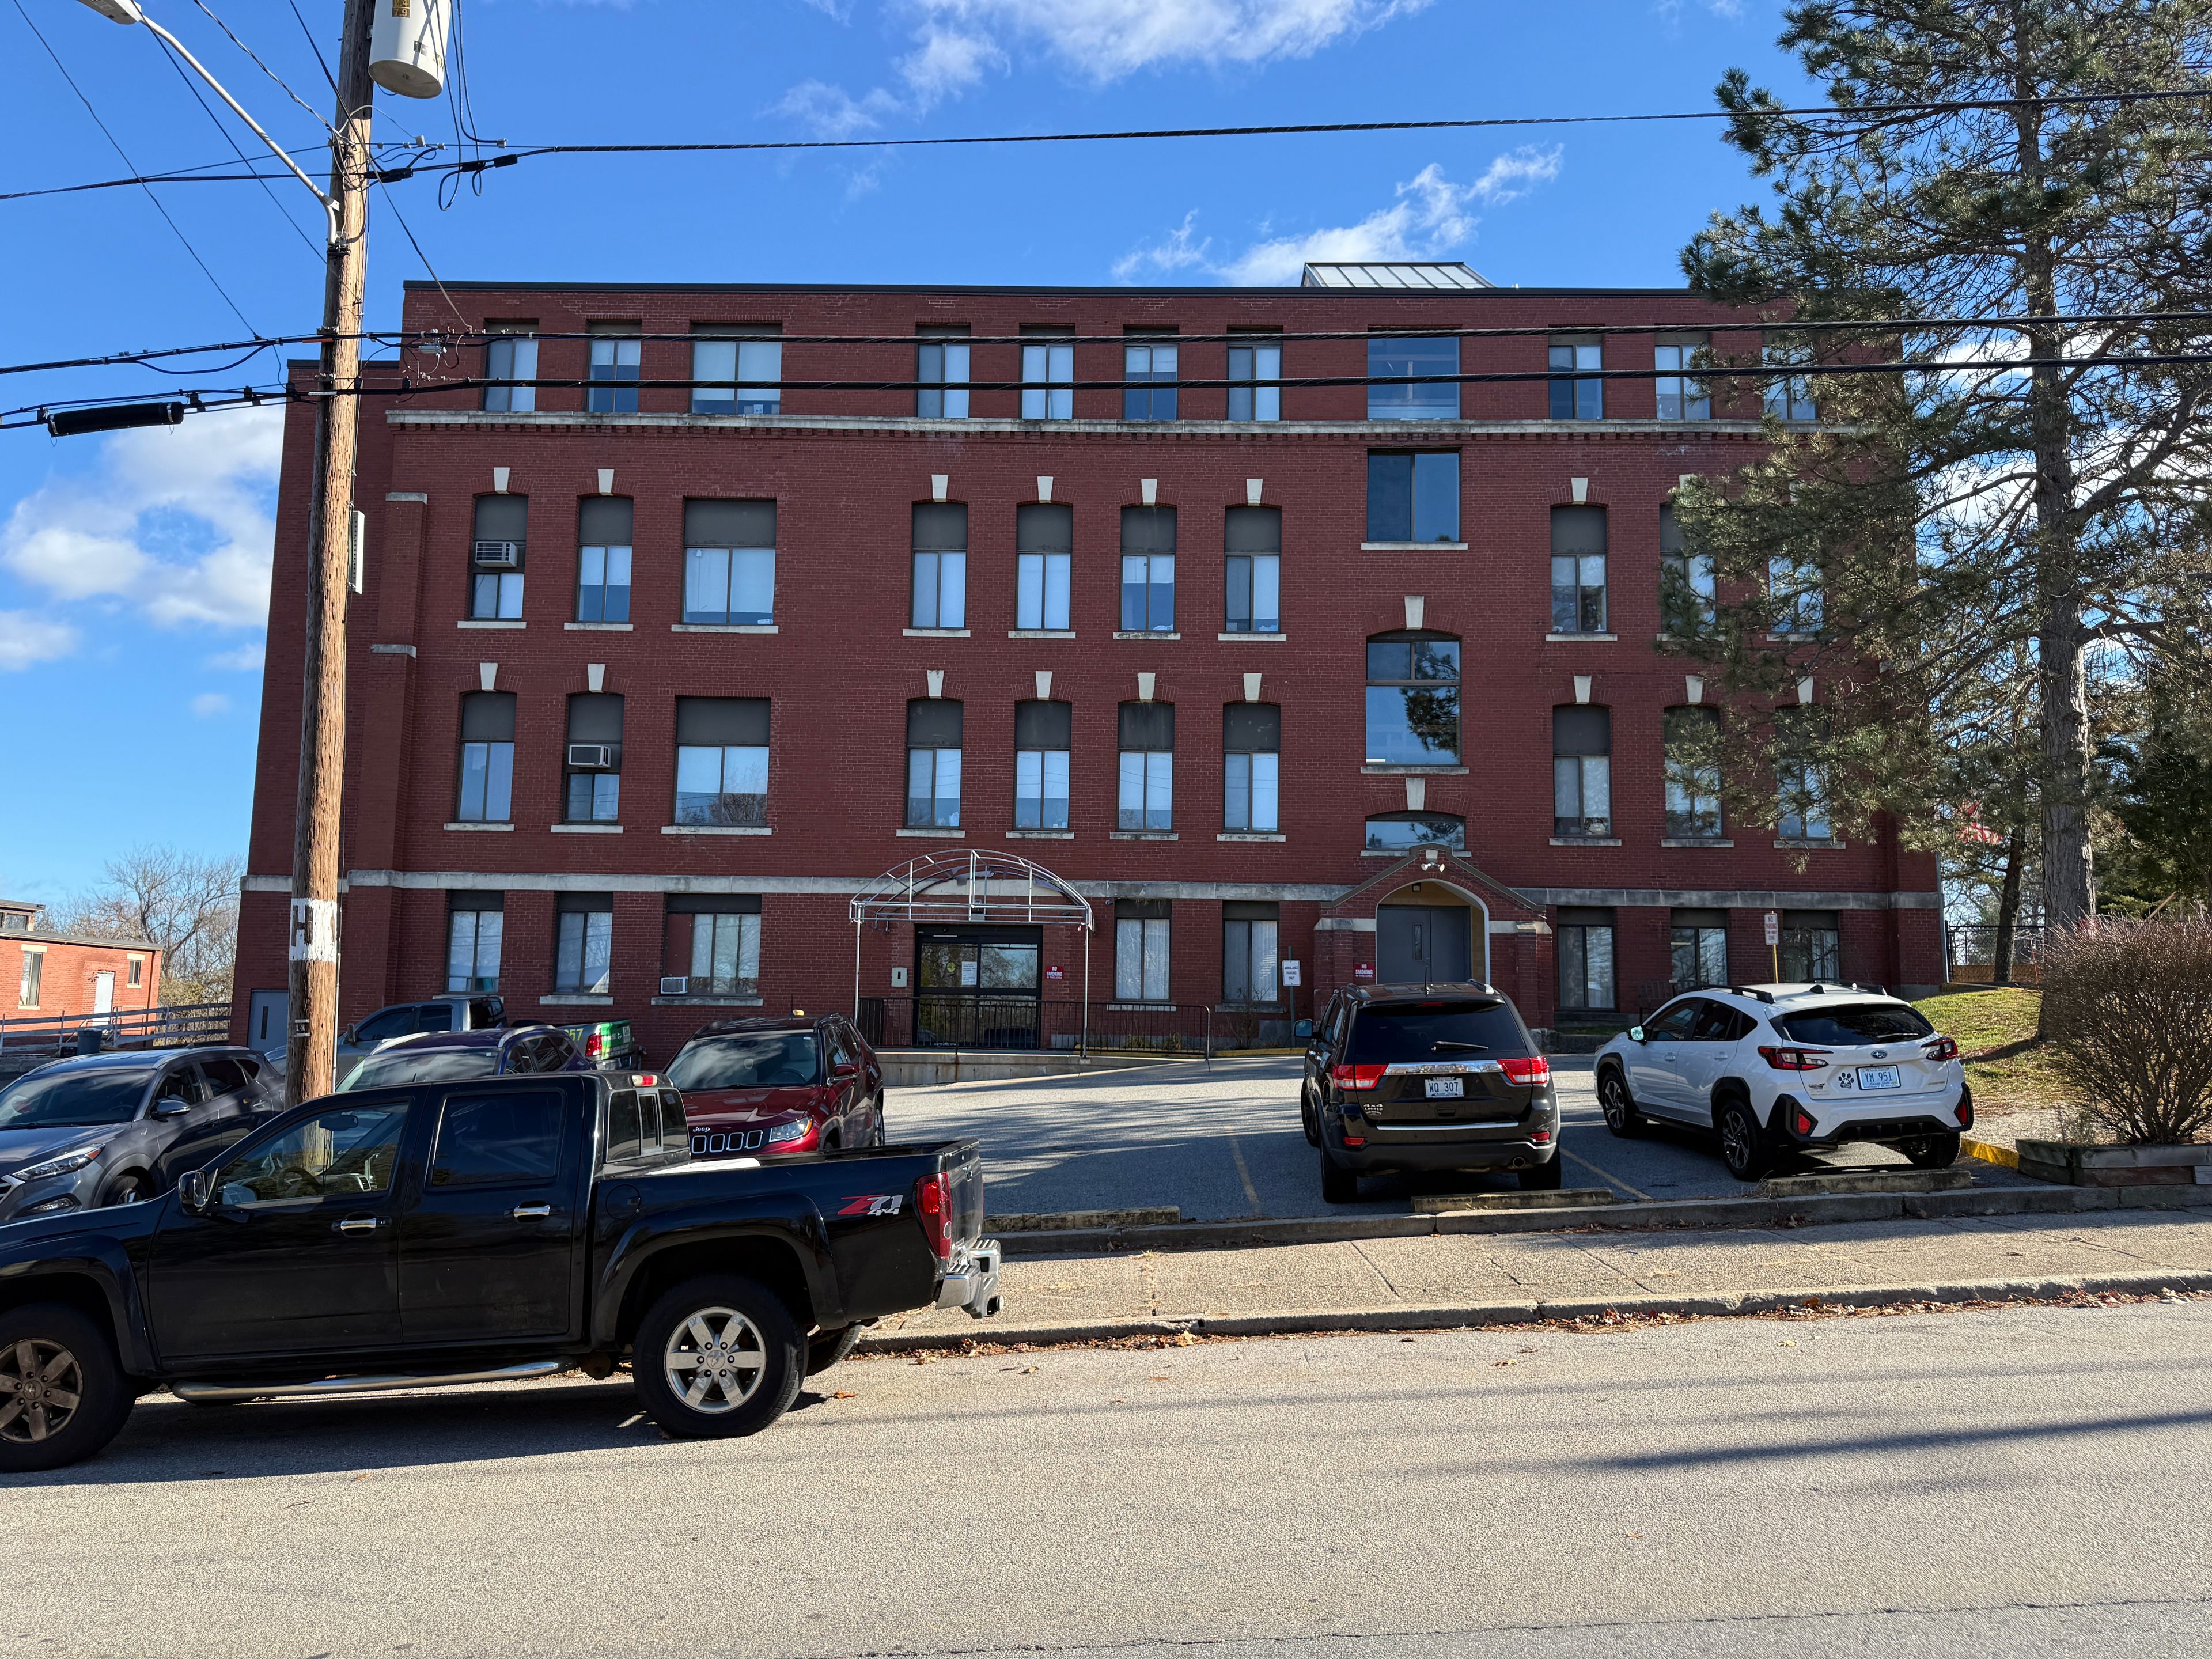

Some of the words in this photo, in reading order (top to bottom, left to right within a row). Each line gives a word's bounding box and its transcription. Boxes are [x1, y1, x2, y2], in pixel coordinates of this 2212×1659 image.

[394, 9, 408, 17] 7.9
[291, 905, 313, 946] H
[1865, 1073, 1874, 1083] YM
[1878, 1071, 1893, 1082] 951
[1444, 1082, 1459, 1092] 307
[838, 1194, 903, 1215] Z71
[867, 1207, 900, 1217] 4x4
